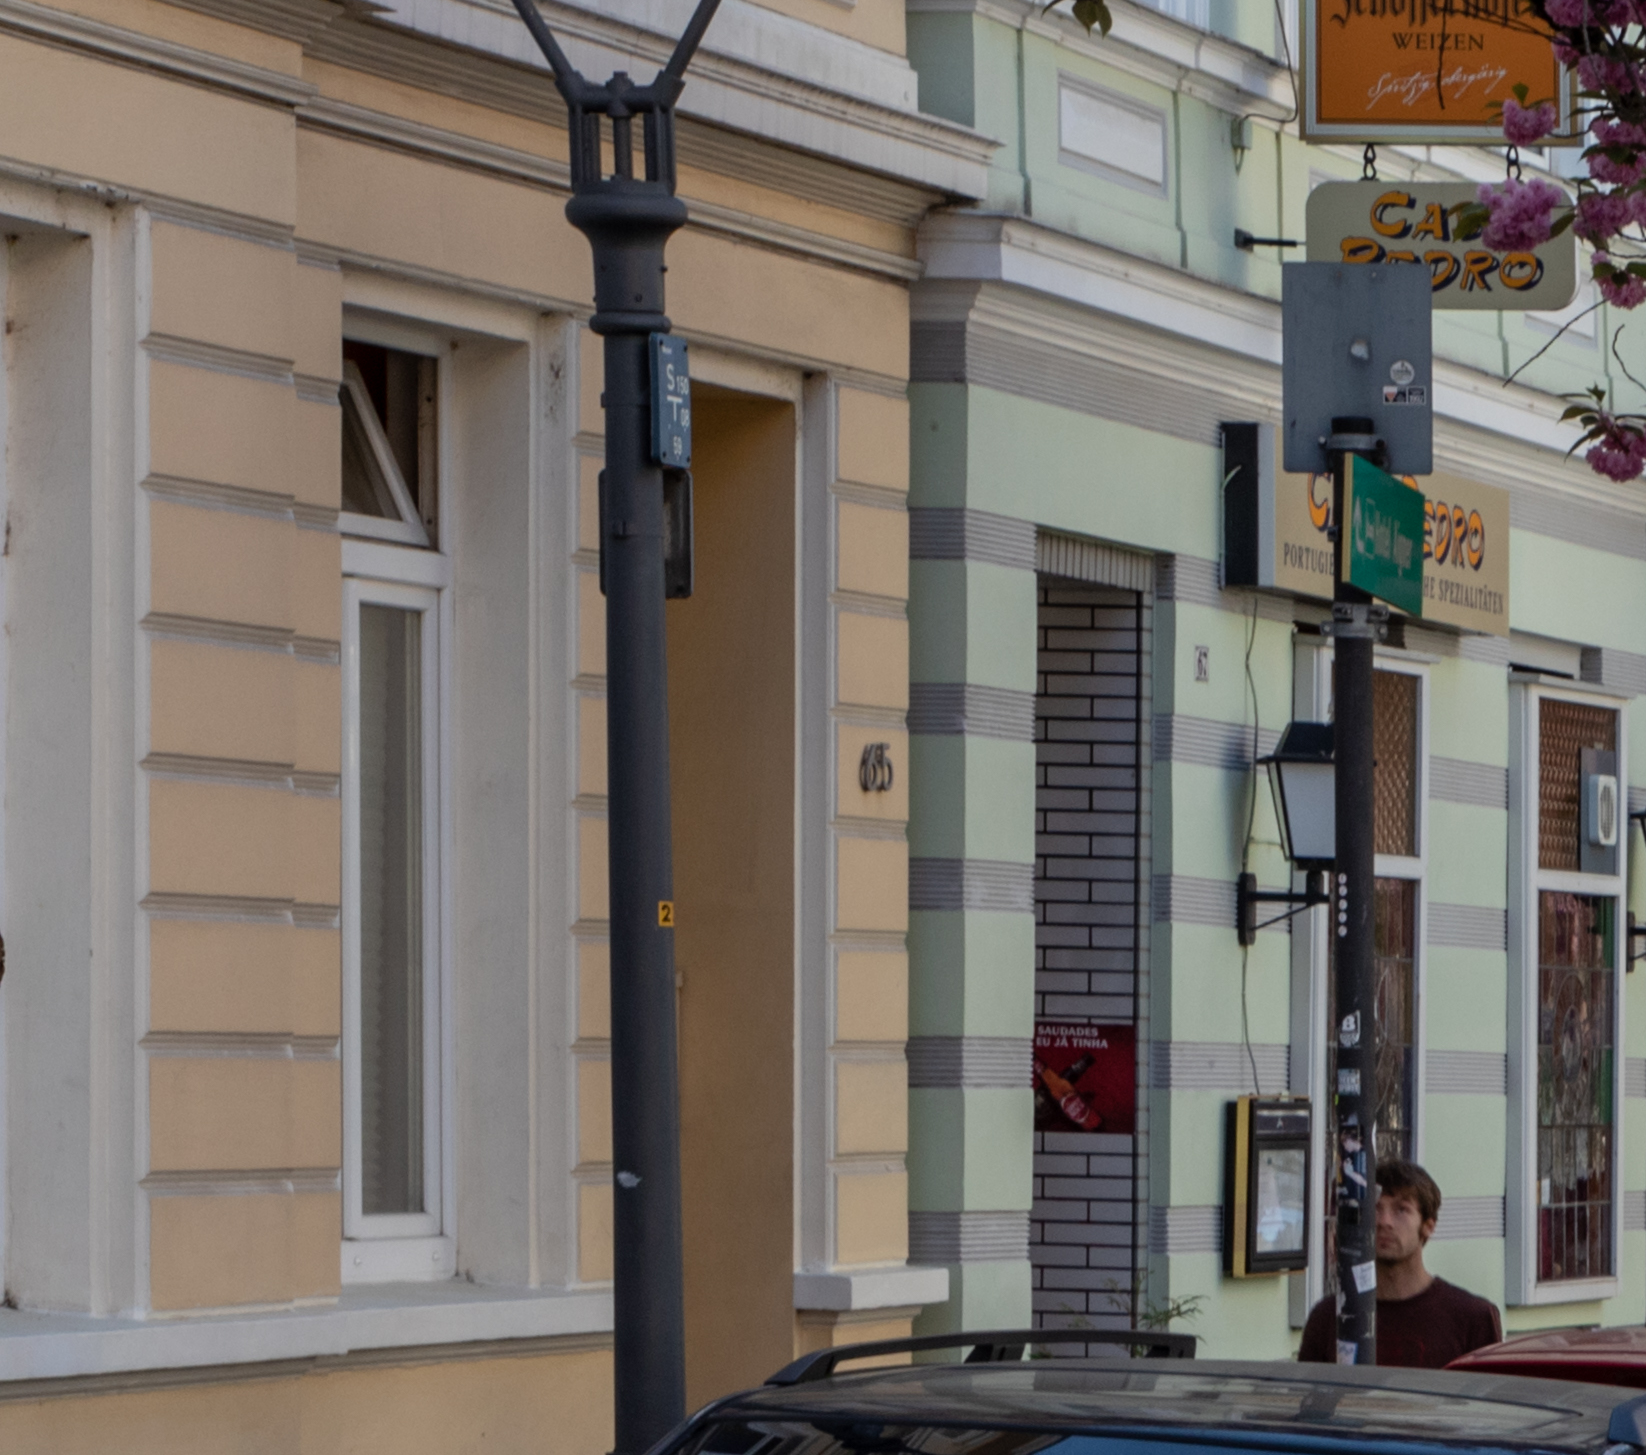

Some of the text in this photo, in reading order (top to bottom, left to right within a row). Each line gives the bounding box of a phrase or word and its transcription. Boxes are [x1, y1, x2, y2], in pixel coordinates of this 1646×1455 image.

[1392, 32, 1485, 51] WEIZEN
[1437, 577, 1504, 615] SPEZIALITÄTEN
[661, 904, 671, 922] 2
[1037, 1026, 1098, 1037] SAUDADES
[1036, 1035, 1108, 1049] EU JÁ TINHA
